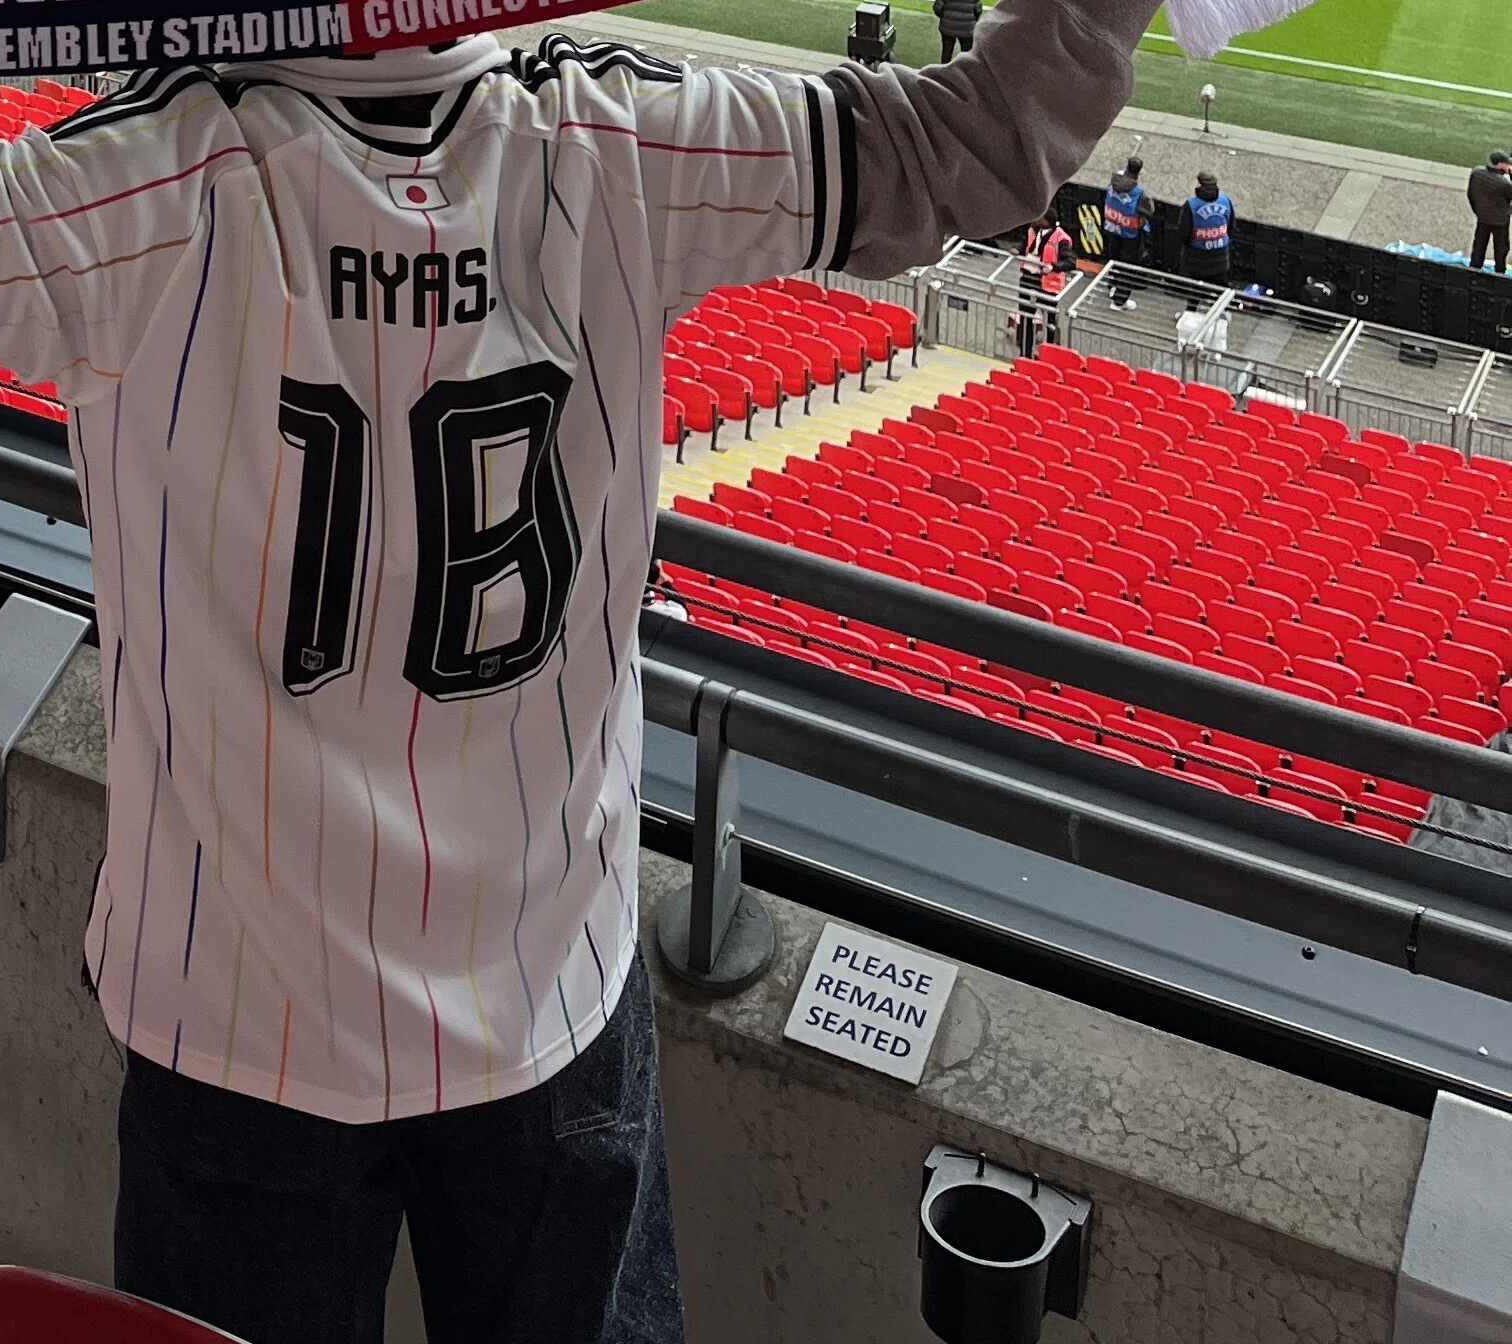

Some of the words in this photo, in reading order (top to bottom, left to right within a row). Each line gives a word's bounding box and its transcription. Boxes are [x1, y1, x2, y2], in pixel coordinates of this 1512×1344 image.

[163, 3, 353, 58] STADIUM
[329, 245, 497, 330] AYAS
[277, 359, 583, 703] 18
[831, 944, 933, 996] PLEASE
[814, 972, 927, 1029] REMAIN
[804, 1005, 911, 1058] SEATED
